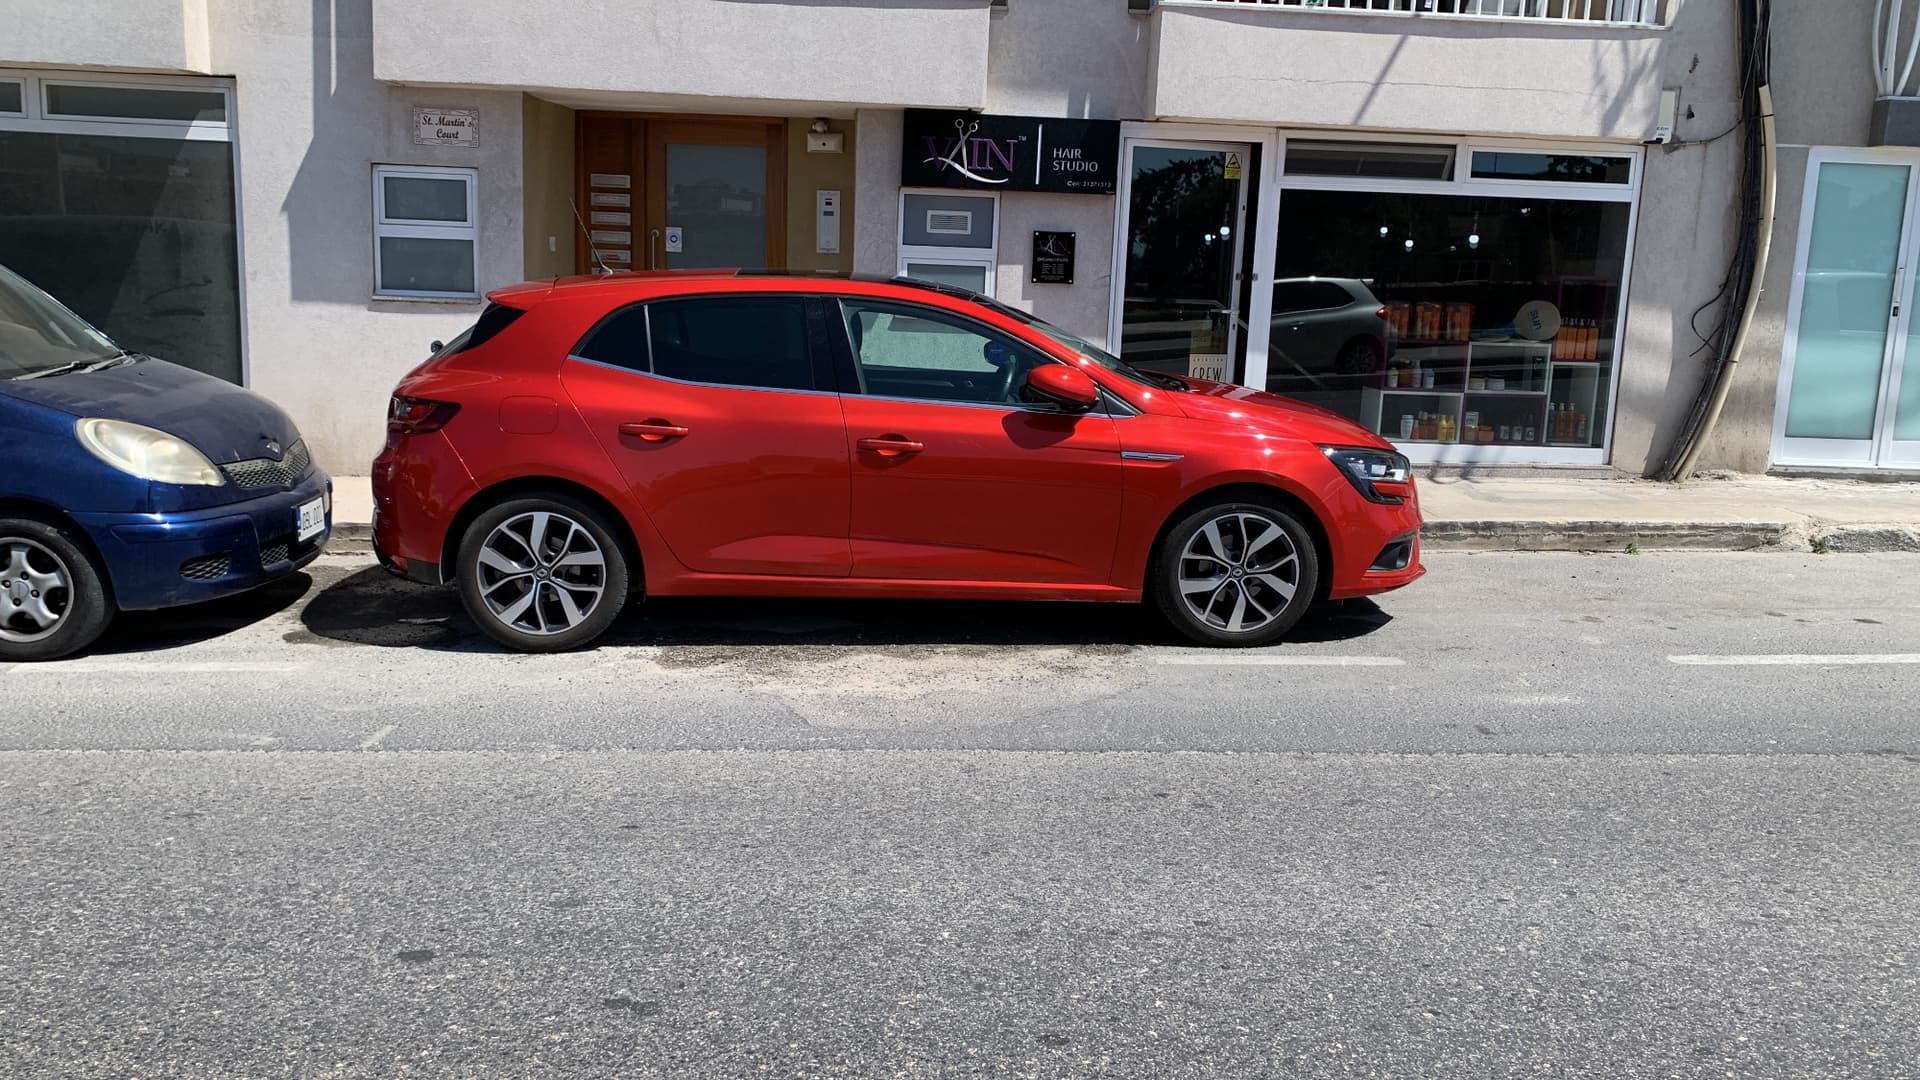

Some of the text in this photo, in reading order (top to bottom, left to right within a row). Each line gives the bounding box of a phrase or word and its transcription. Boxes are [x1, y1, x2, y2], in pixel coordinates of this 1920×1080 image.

[422, 115, 473, 128] St. Martin's
[436, 128, 459, 139] Court
[1053, 147, 1082, 159] HAIR
[1053, 160, 1098, 172] STUDIO
